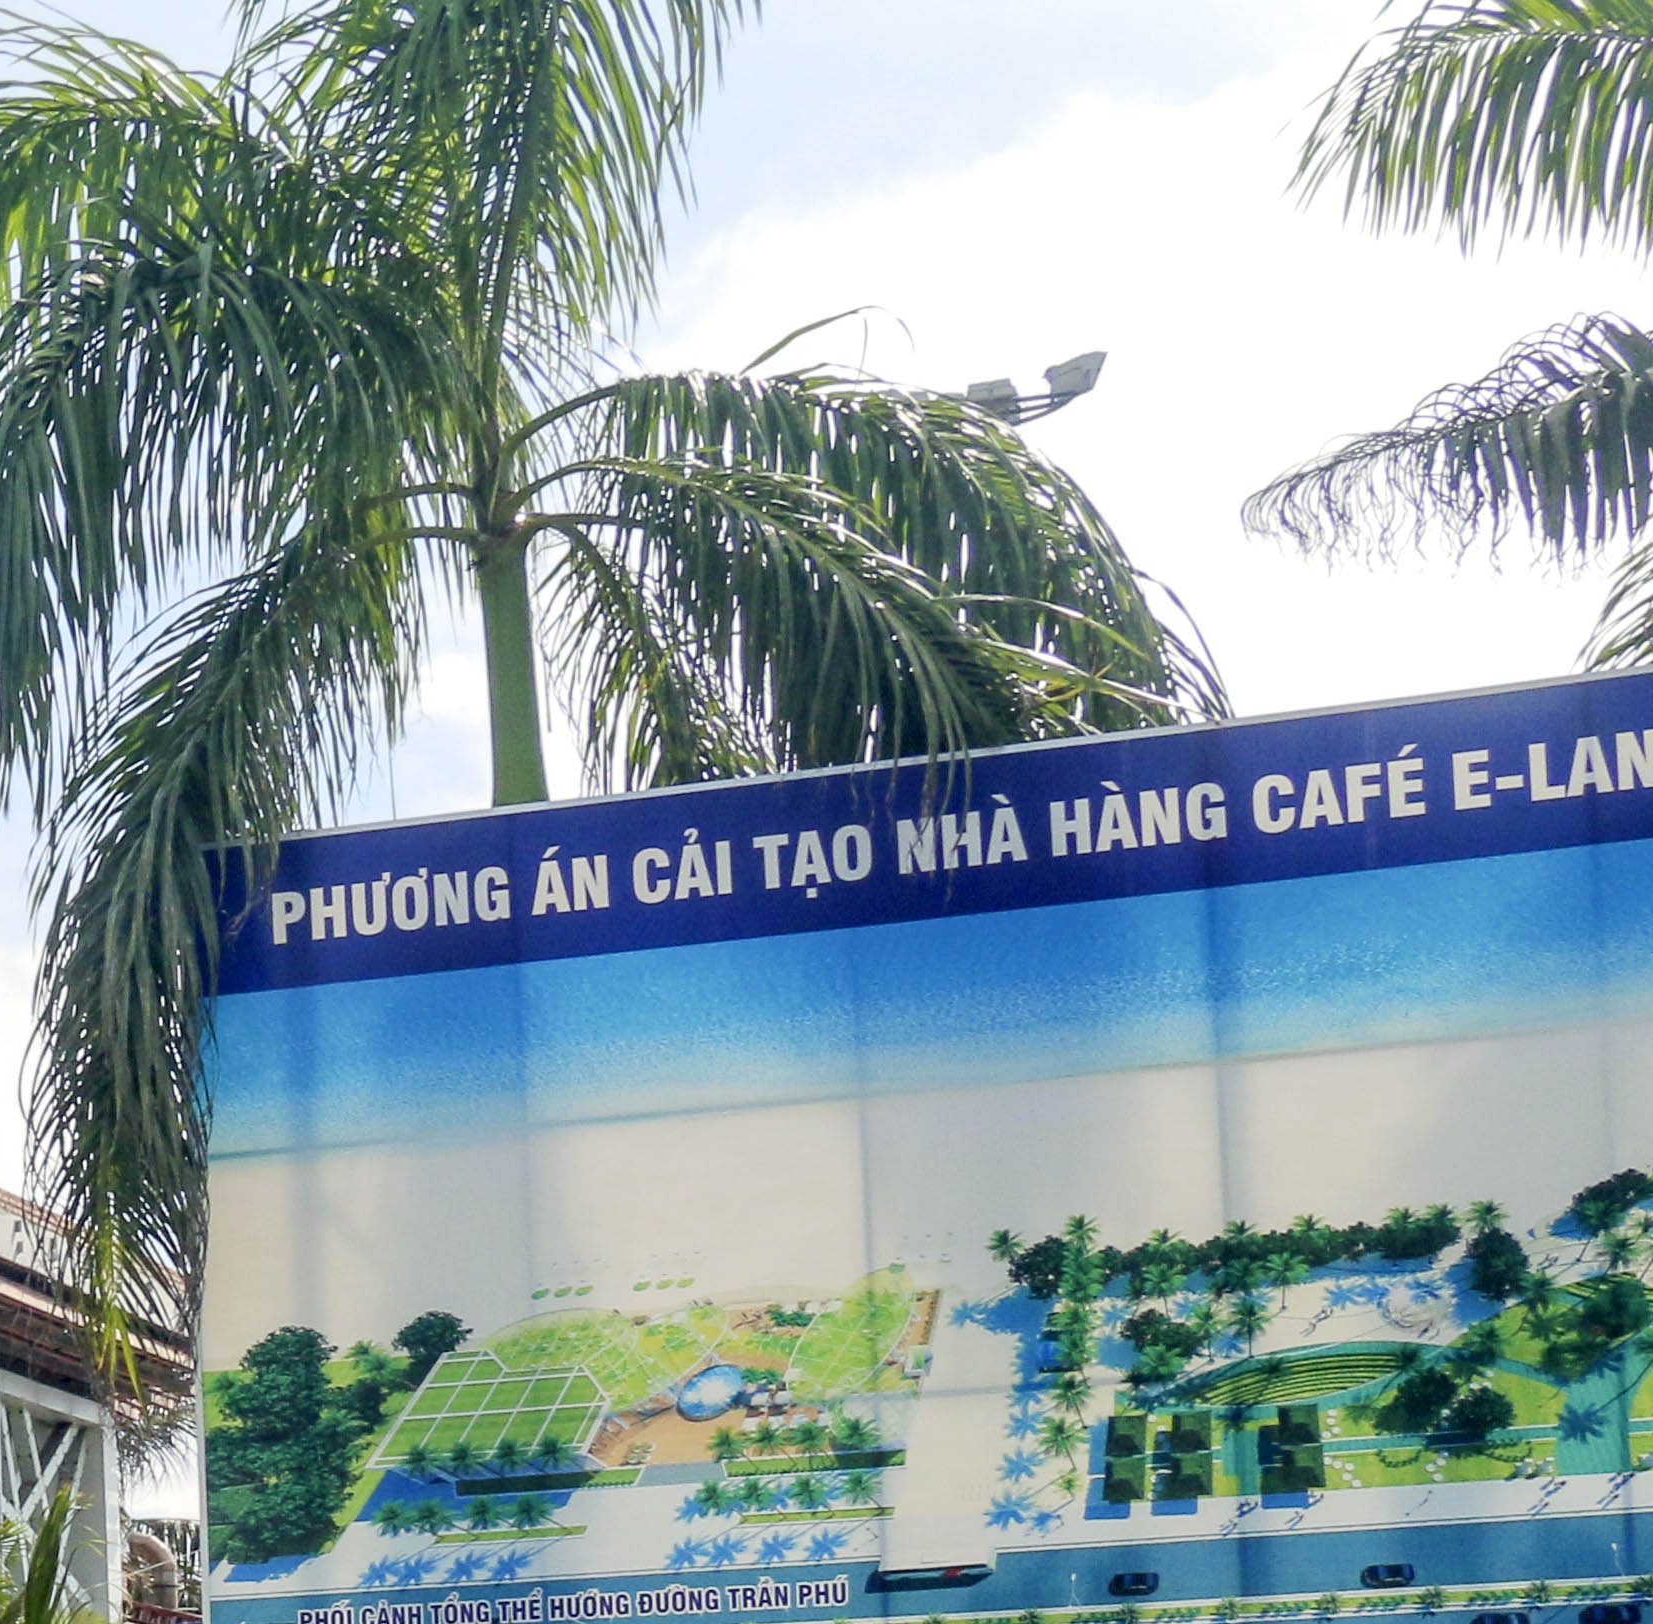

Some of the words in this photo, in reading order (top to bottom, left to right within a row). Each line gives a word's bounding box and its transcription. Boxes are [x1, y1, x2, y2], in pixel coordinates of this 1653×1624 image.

[271, 866, 511, 945] PHƯƠNG
[531, 845, 610, 916] ÁN
[632, 828, 733, 904] CẢI
[752, 824, 872, 898] TẠO
[896, 794, 1029, 875] NHÀ
[1049, 781, 1228, 857] HÀNG
[1252, 743, 1427, 835] CAFÉ
[1452, 728, 1653, 811] E-LAN
[497, 1586, 544, 1623] THỂ
[548, 1588, 631, 1621] HƯỚNG
[636, 1583, 721, 1615] ĐƯỜNG
[726, 1575, 791, 1611] TRẦN
[796, 1574, 850, 1607] PHÚ
